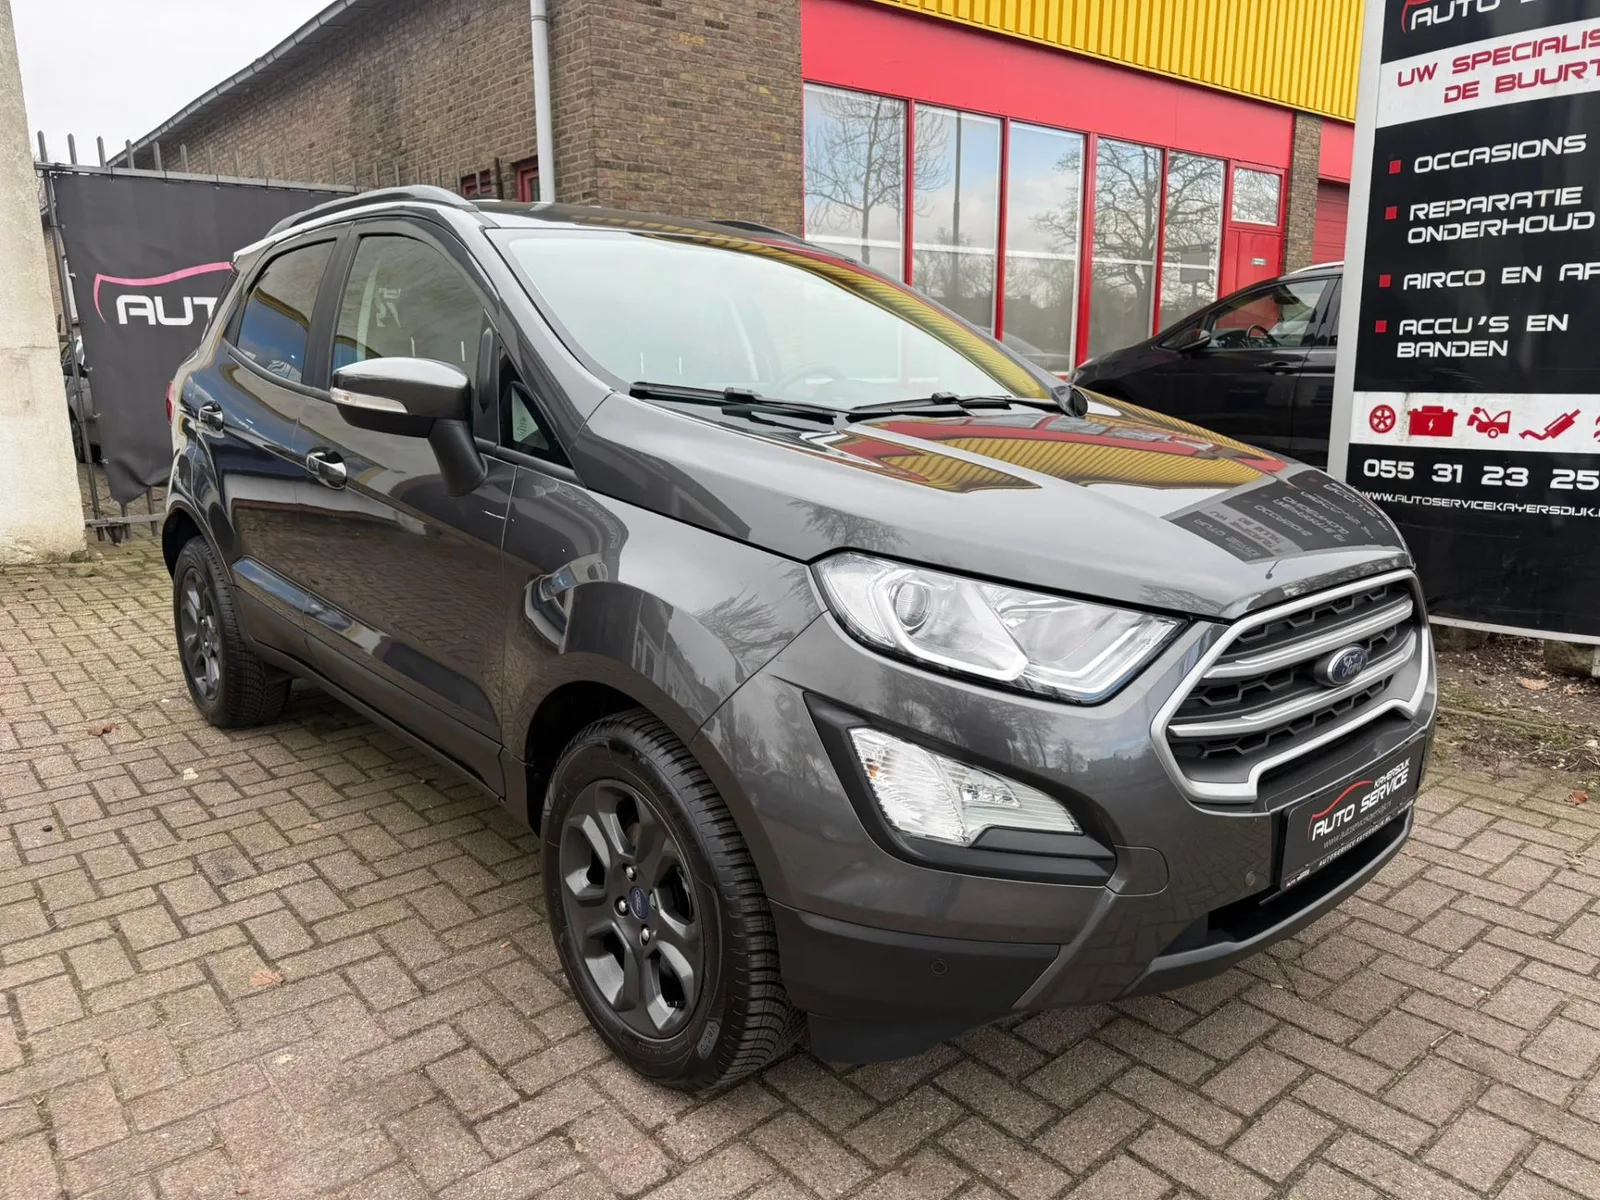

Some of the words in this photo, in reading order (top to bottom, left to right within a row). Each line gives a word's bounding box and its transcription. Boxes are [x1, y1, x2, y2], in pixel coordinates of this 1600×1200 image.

[1411, 0, 1500, 30] AUTO
[1397, 63, 1438, 87] UW
[1444, 81, 1480, 103] DE
[1414, 134, 1587, 173] OCCASIONS
[1409, 186, 1583, 221] REPARATIE
[1407, 211, 1596, 244] ONDERHOUD
[1403, 269, 1486, 290] AIRCO
[1501, 265, 1543, 285] EN
[1399, 315, 1510, 336] ACCU'S
[1526, 314, 1569, 332] EN
[1397, 340, 1508, 358] BANDEN
[1363, 459, 1415, 480] 055
[1431, 463, 1463, 483] 31
[1481, 465, 1529, 487] 23
[1550, 469, 1599, 490] 25
[1361, 491, 1600, 517] WWW.AUTOSERVICEKAYERSDIJK.
[1341, 651, 1364, 678] Ford
[1312, 803, 1355, 841] AUTO
[1360, 768, 1410, 813] SERVICE
